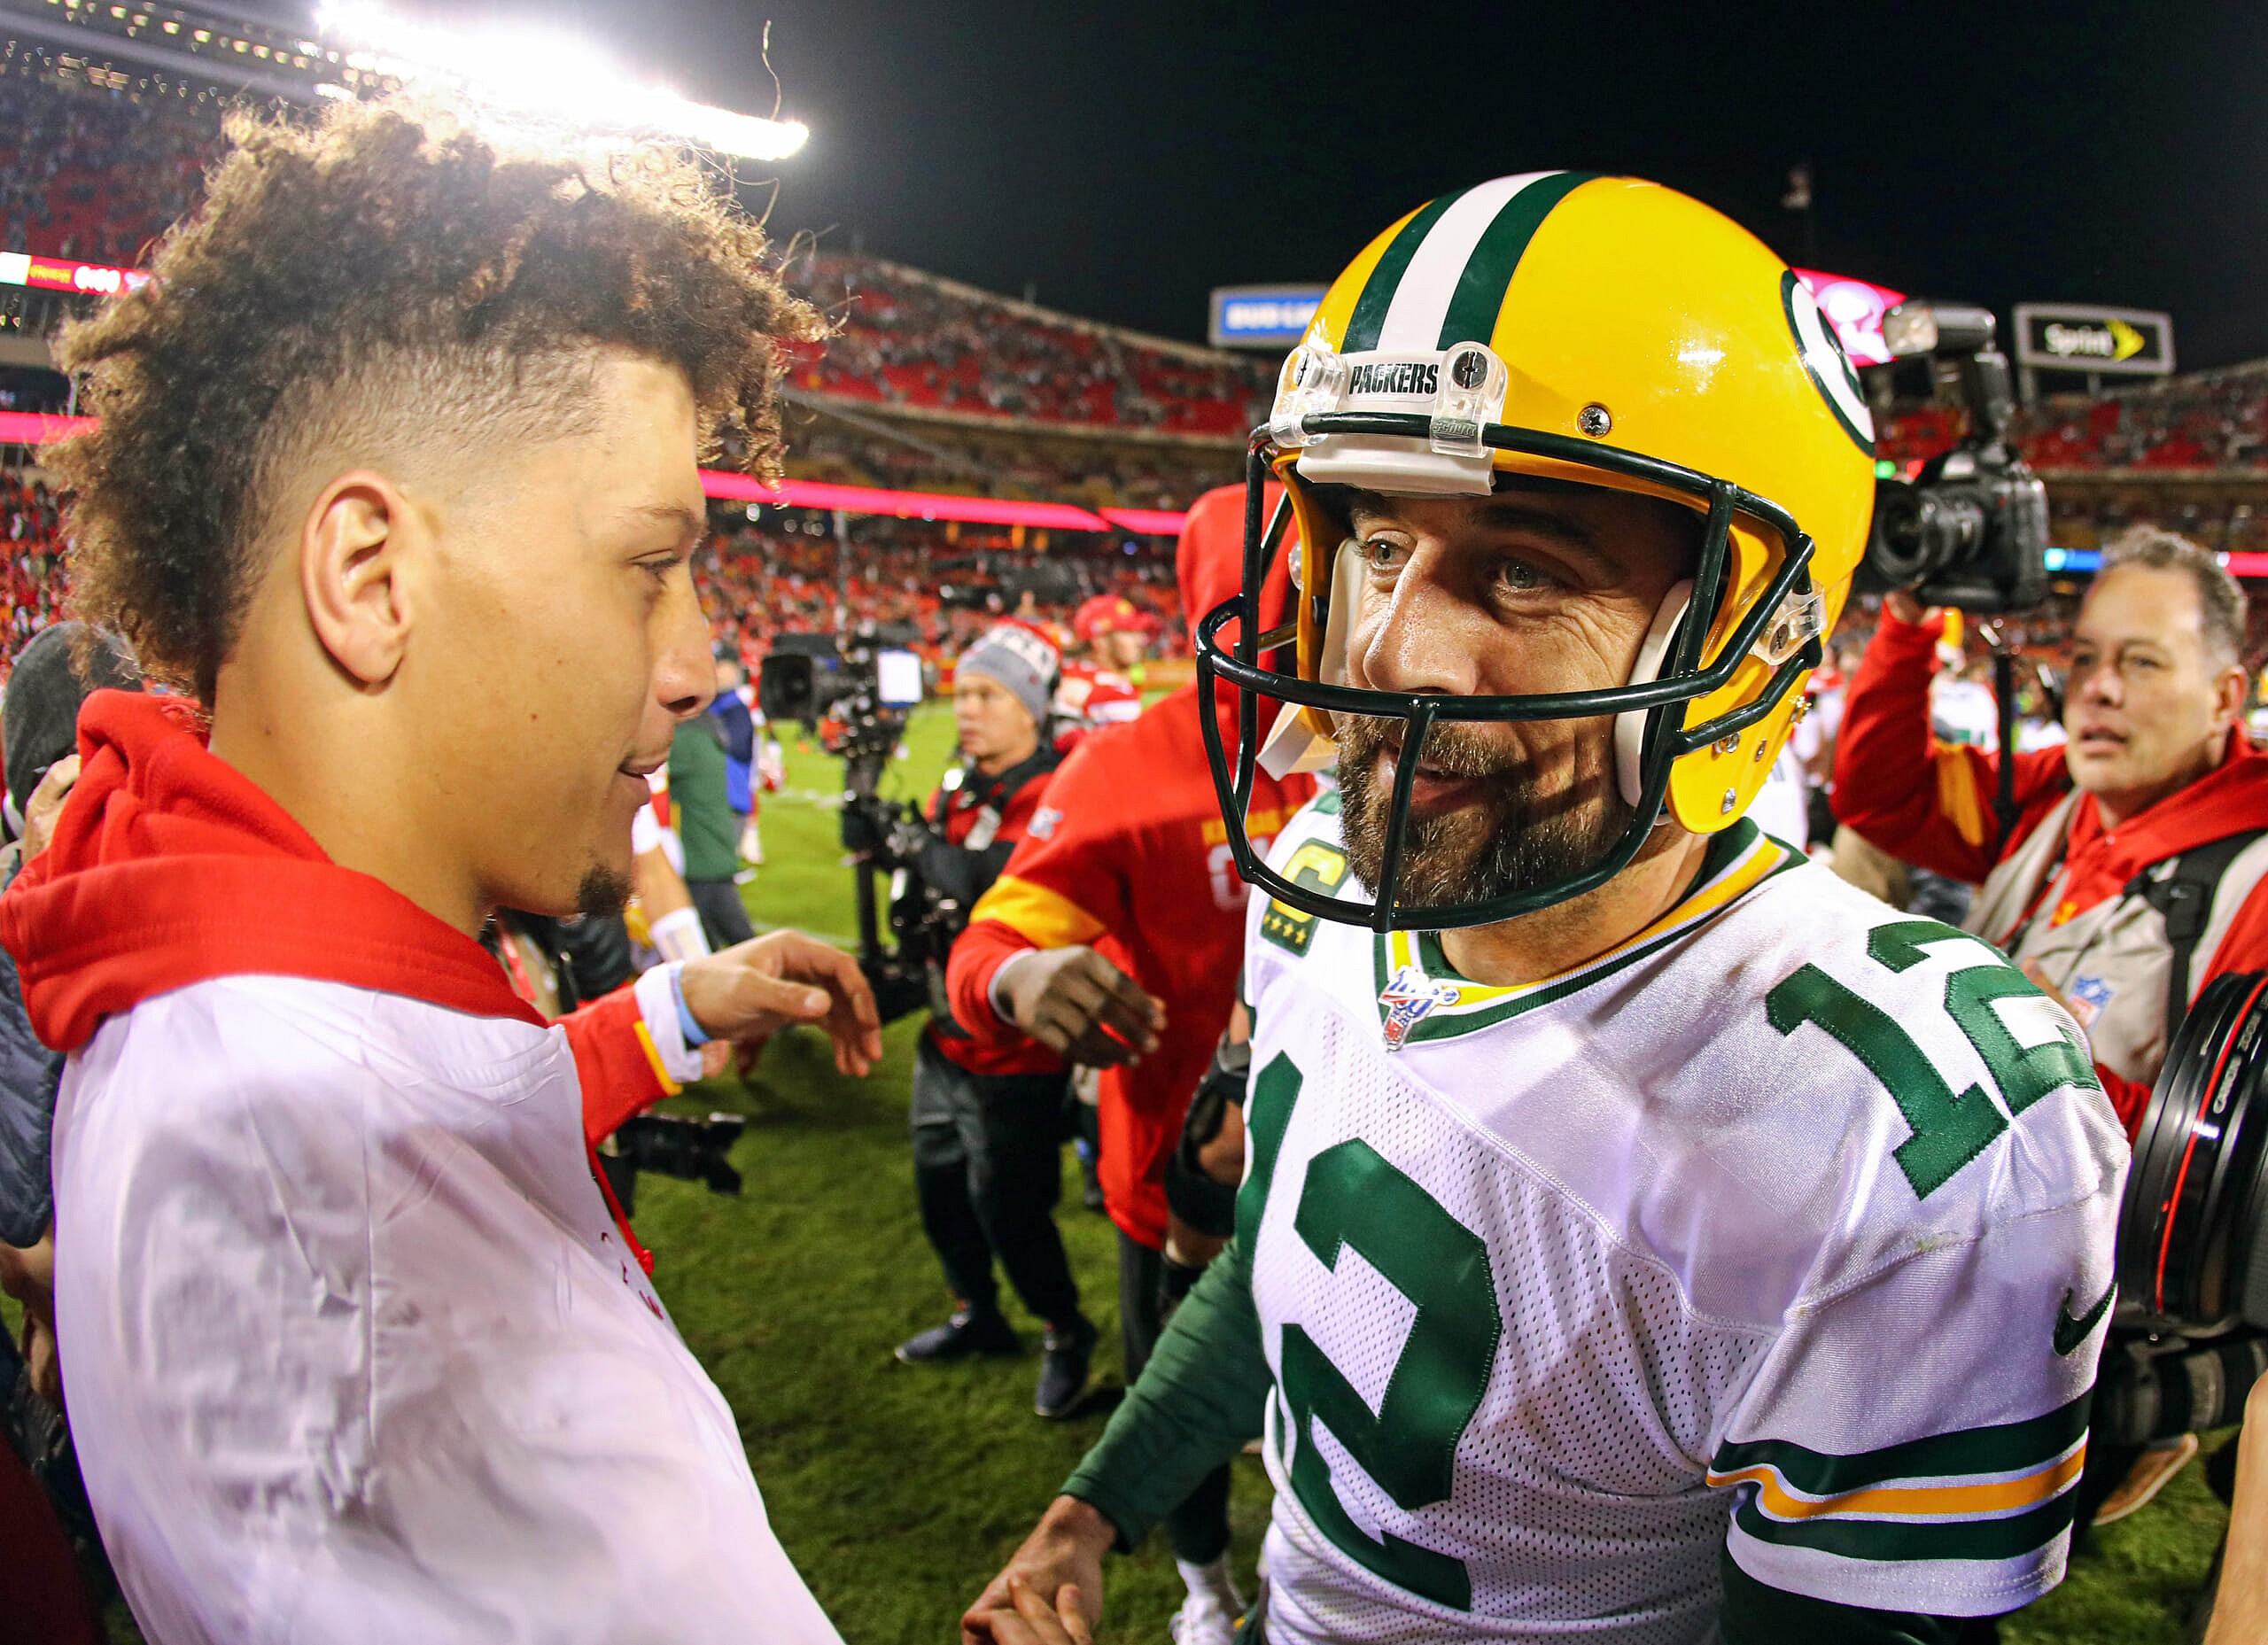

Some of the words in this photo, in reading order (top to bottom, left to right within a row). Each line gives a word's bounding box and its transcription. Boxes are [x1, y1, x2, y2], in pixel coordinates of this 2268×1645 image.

[1348, 362, 1440, 395] PACKERS
[2045, 323, 2115, 359] Sprint
[1766, 920, 2101, 1202] 12
[1234, 1050, 1503, 1613] 12
